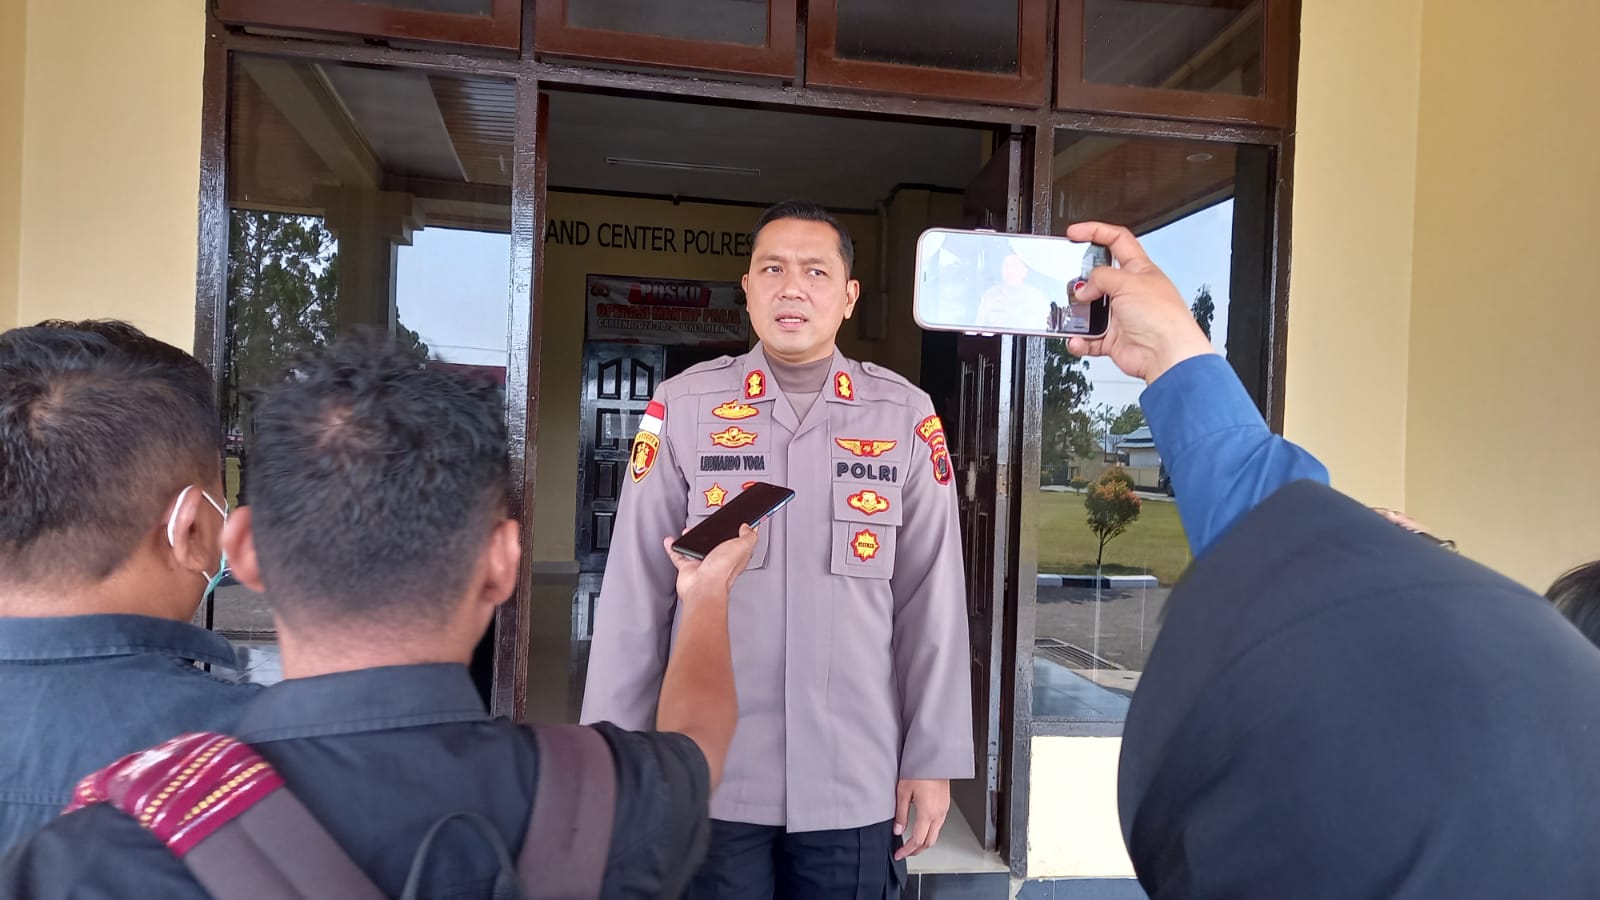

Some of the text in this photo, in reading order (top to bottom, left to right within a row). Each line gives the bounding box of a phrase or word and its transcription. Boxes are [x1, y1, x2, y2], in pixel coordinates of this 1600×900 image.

[597, 223, 677, 252] CENTER
[700, 455, 765, 471] LEONARDO YOGA
[837, 462, 897, 483] POLRI
